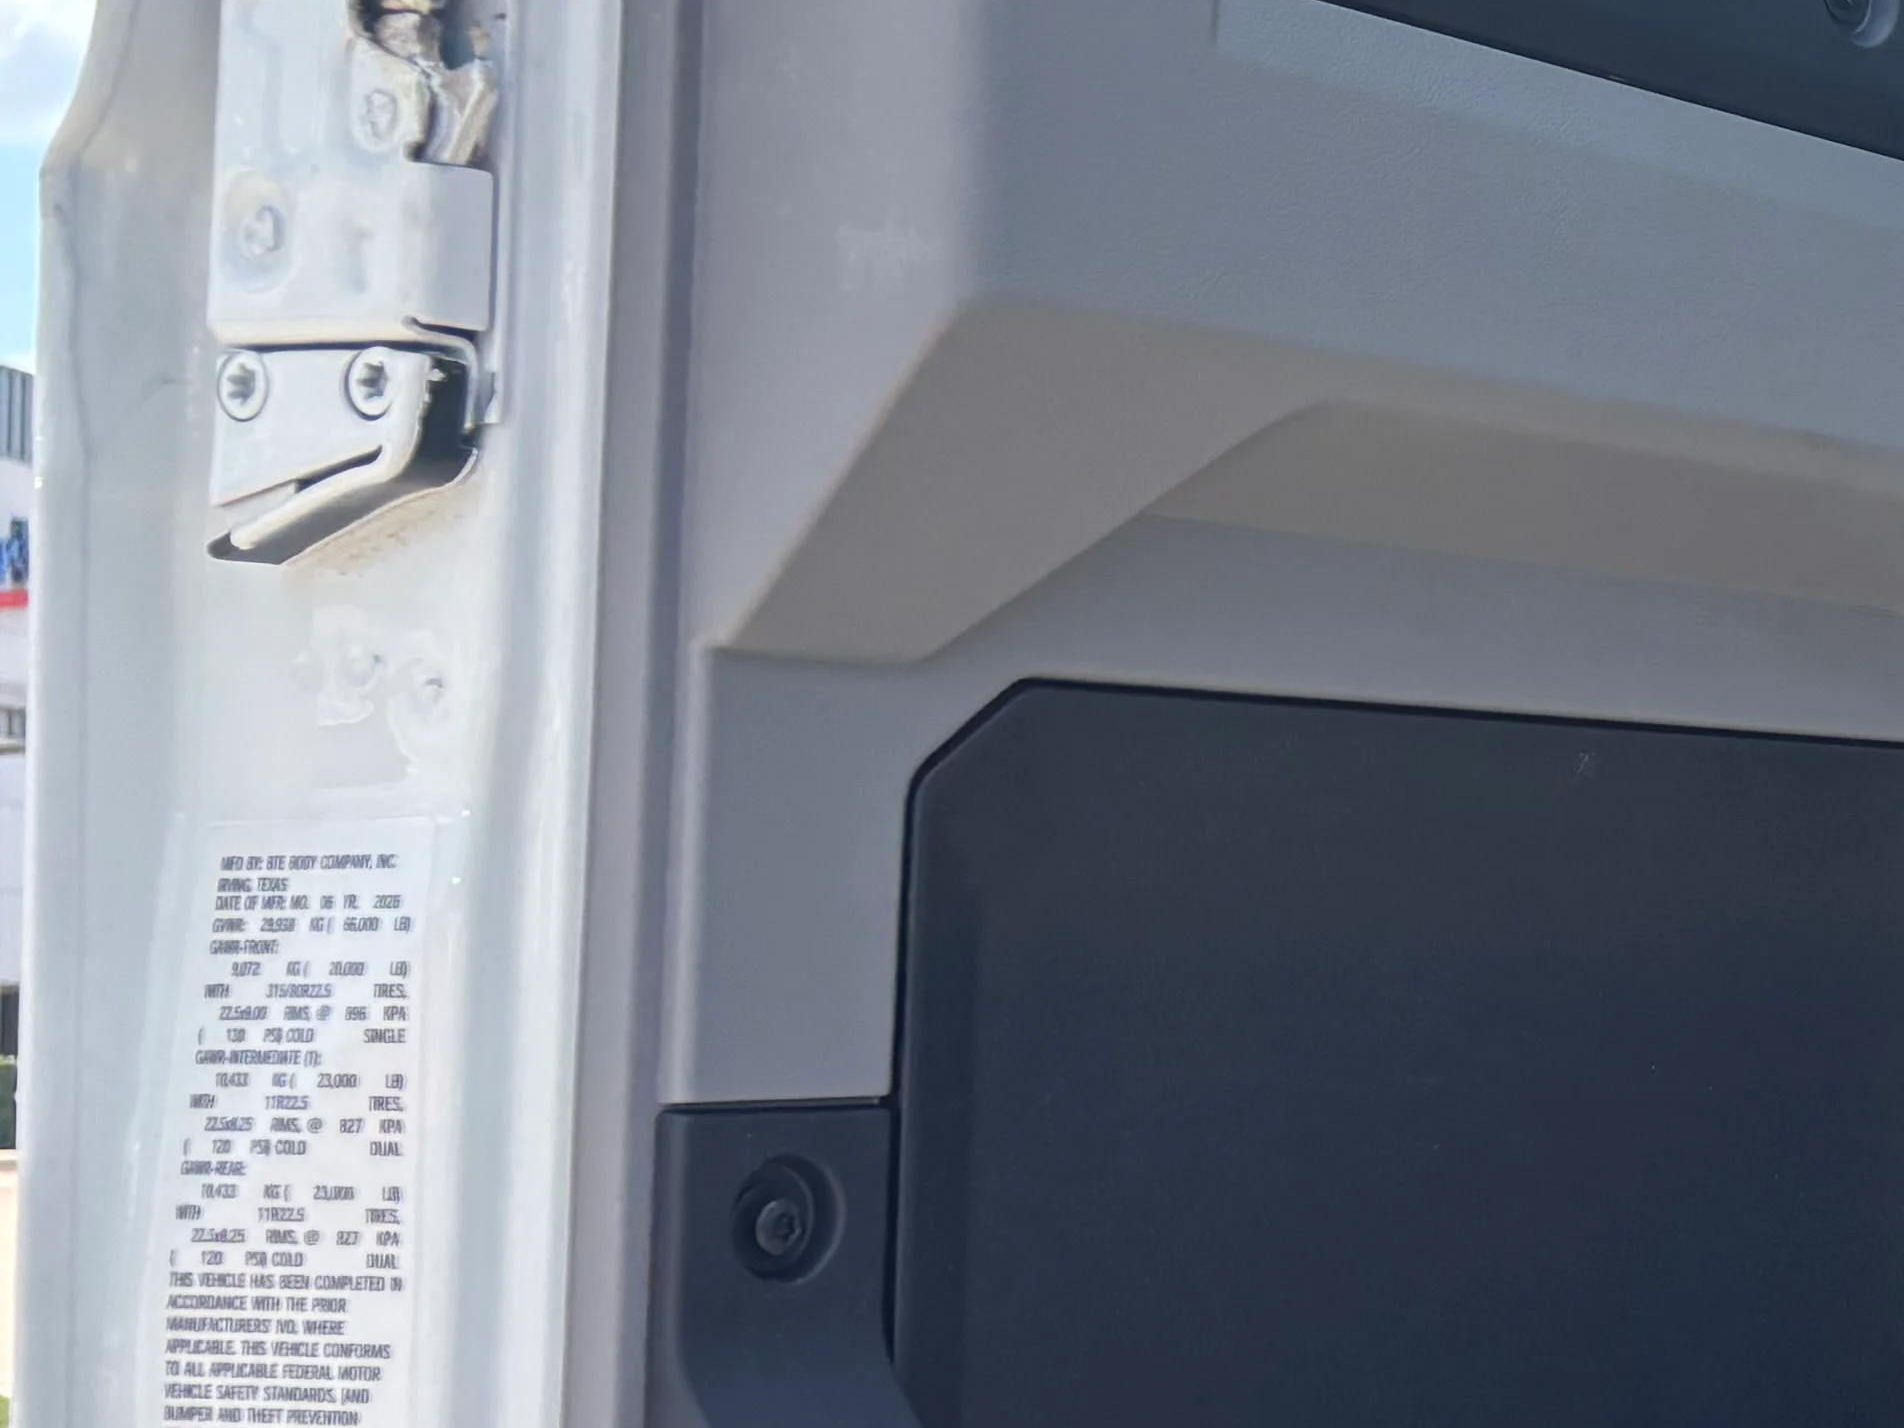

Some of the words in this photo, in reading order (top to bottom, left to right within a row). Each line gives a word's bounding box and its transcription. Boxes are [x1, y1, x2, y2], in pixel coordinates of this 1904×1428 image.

[257, 877, 288, 892] TEXAS
[198, 1272, 245, 1288] VEHICLE
[250, 1274, 275, 1289] HAS
[279, 1275, 310, 1290] BEEN
[314, 1275, 385, 1291] COMPLETED
[166, 1294, 248, 1310] ACCORDANCE
[251, 1296, 280, 1311] WITH
[286, 1297, 307, 1312] THE
[312, 1298, 346, 1313] PRIOR
[302, 1320, 345, 1336] WHERE
[240, 1339, 267, 1355] THIS
[271, 1341, 319, 1357] VEHICLE
[323, 1342, 391, 1359] CONFORMS
[165, 1361, 180, 1376] TO
[184, 1361, 205, 1377] ALL
[209, 1362, 278, 1379] APPLICABLE
[282, 1363, 334, 1380] FEDERAL
[338, 1365, 382, 1381] MOTOR
[164, 1383, 212, 1399] VEHICLE
[216, 1384, 259, 1400] SAFETY
